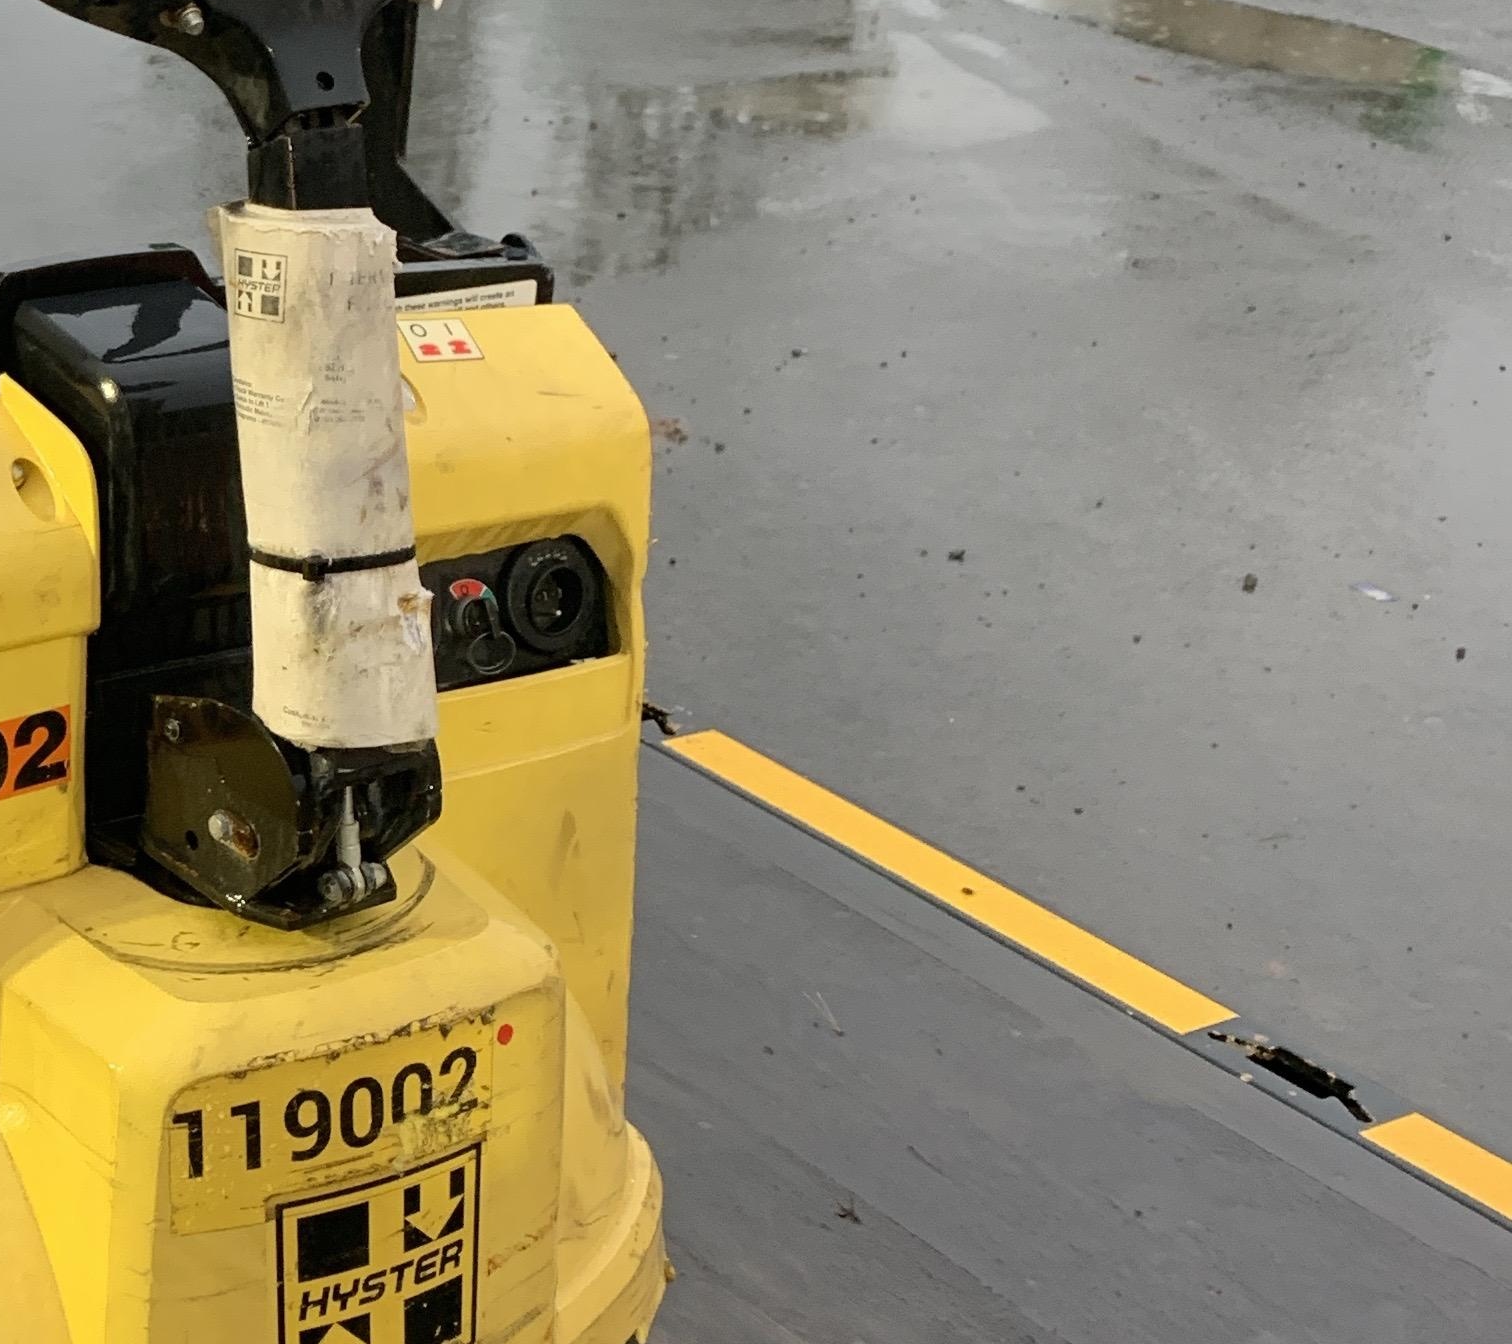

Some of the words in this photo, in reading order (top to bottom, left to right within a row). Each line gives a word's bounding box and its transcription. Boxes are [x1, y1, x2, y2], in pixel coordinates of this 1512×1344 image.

[428, 297, 463, 309] warnings
[465, 294, 479, 304] will
[480, 291, 503, 301] create
[172, 1046, 478, 1179] 119002
[299, 1239, 464, 1322] HYSTER
